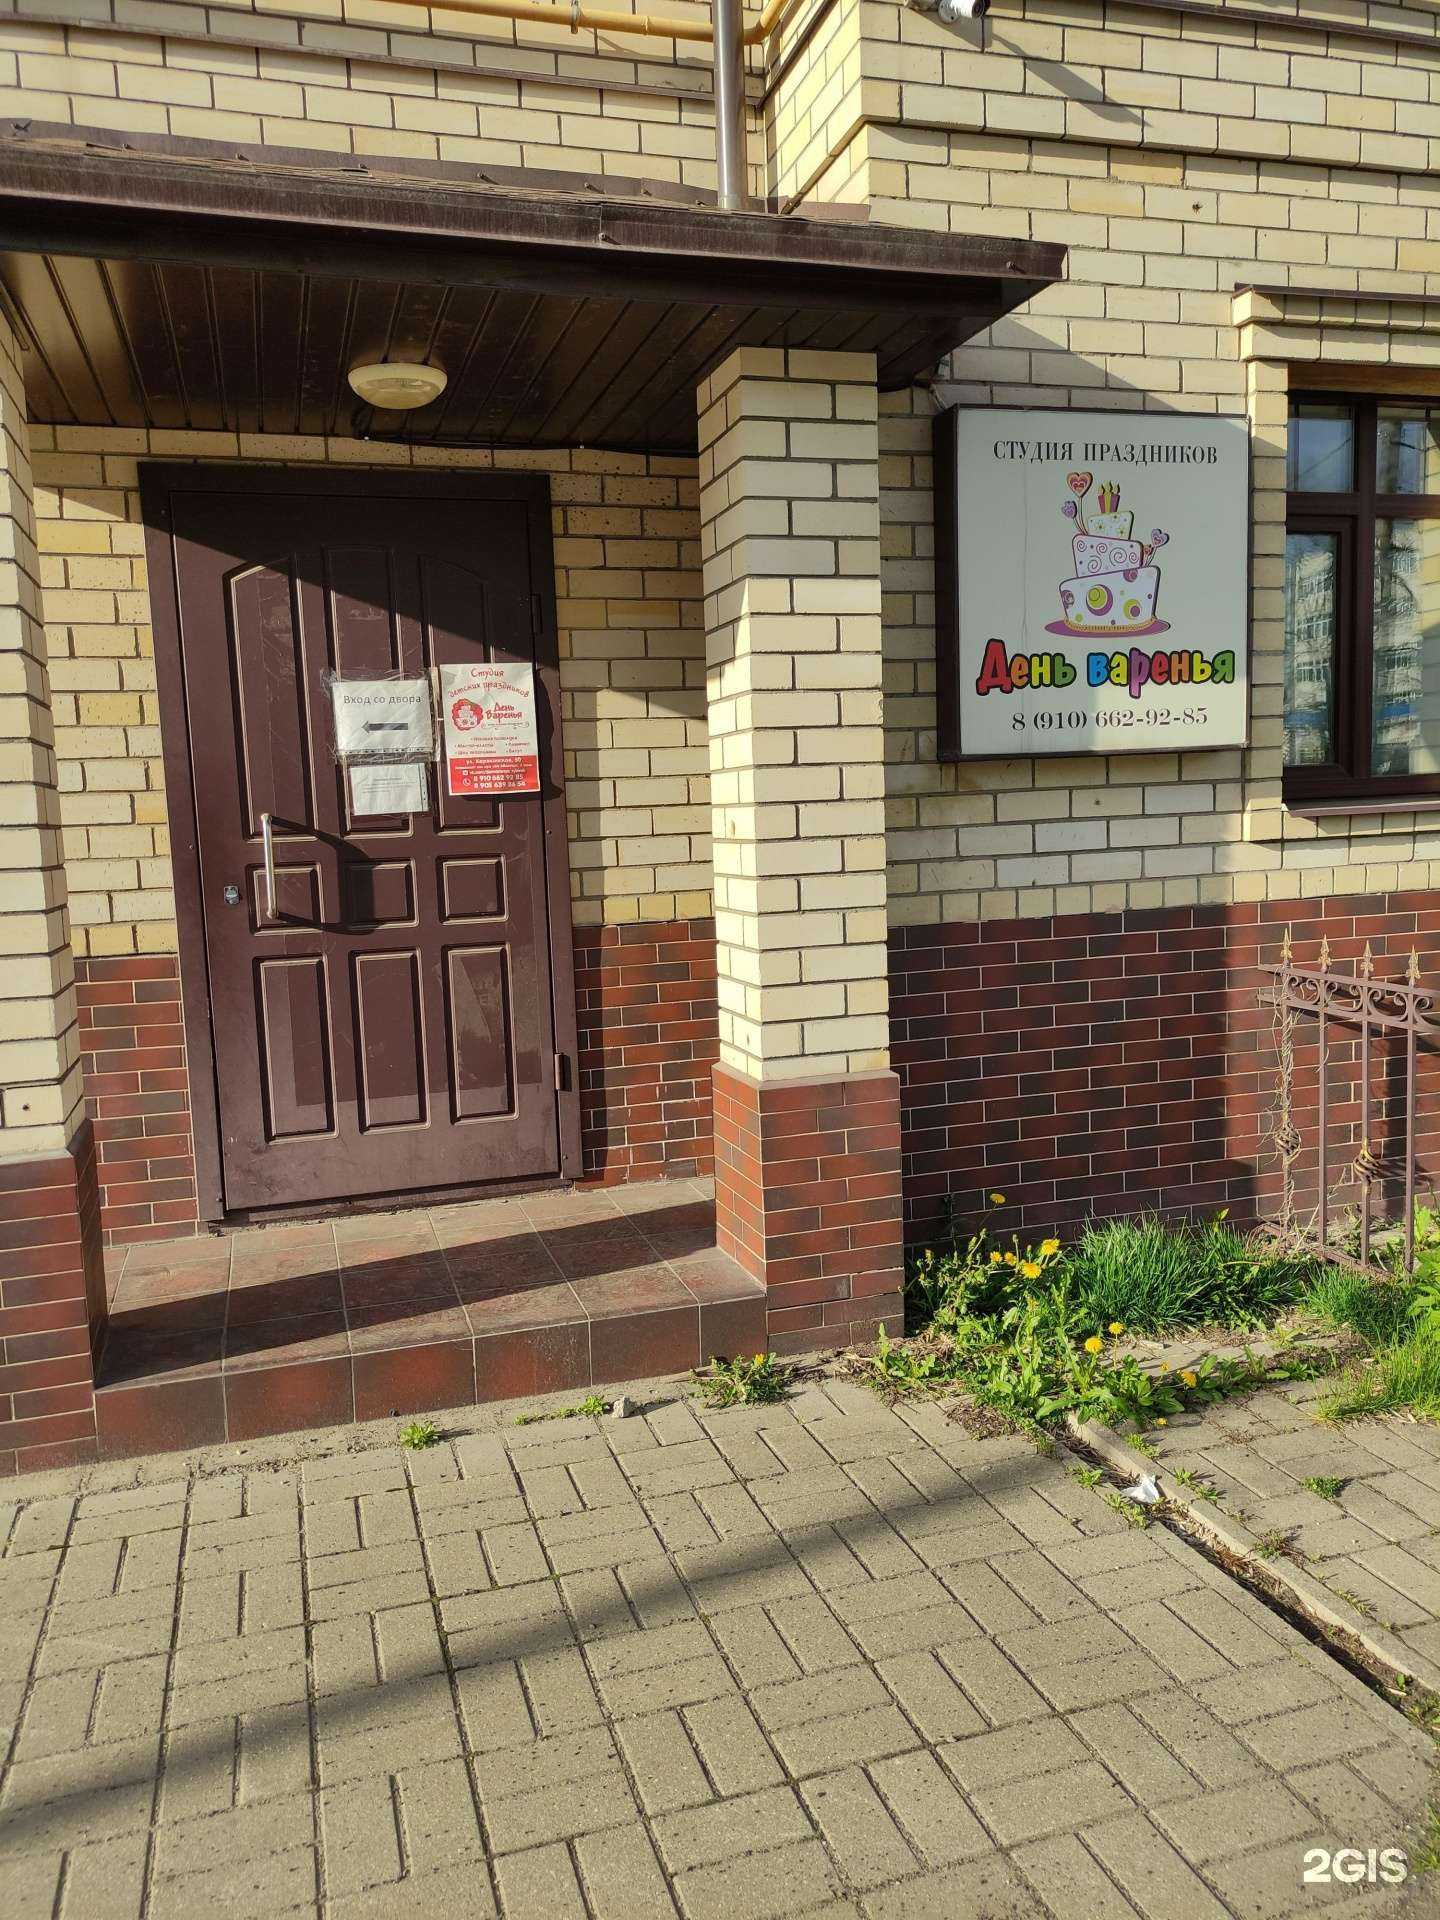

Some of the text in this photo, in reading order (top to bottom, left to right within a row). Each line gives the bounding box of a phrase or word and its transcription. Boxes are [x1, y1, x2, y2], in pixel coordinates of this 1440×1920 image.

[993, 440, 1218, 467] СТУДИЯ ПРАЗДНИКОВ
[471, 667, 504, 680] Студия
[976, 638, 1236, 700] День варенья
[343, 695, 422, 705] Вход со двора
[493, 702, 514, 712] День
[1012, 706, 1209, 732] 8 (910) 662-92-85
